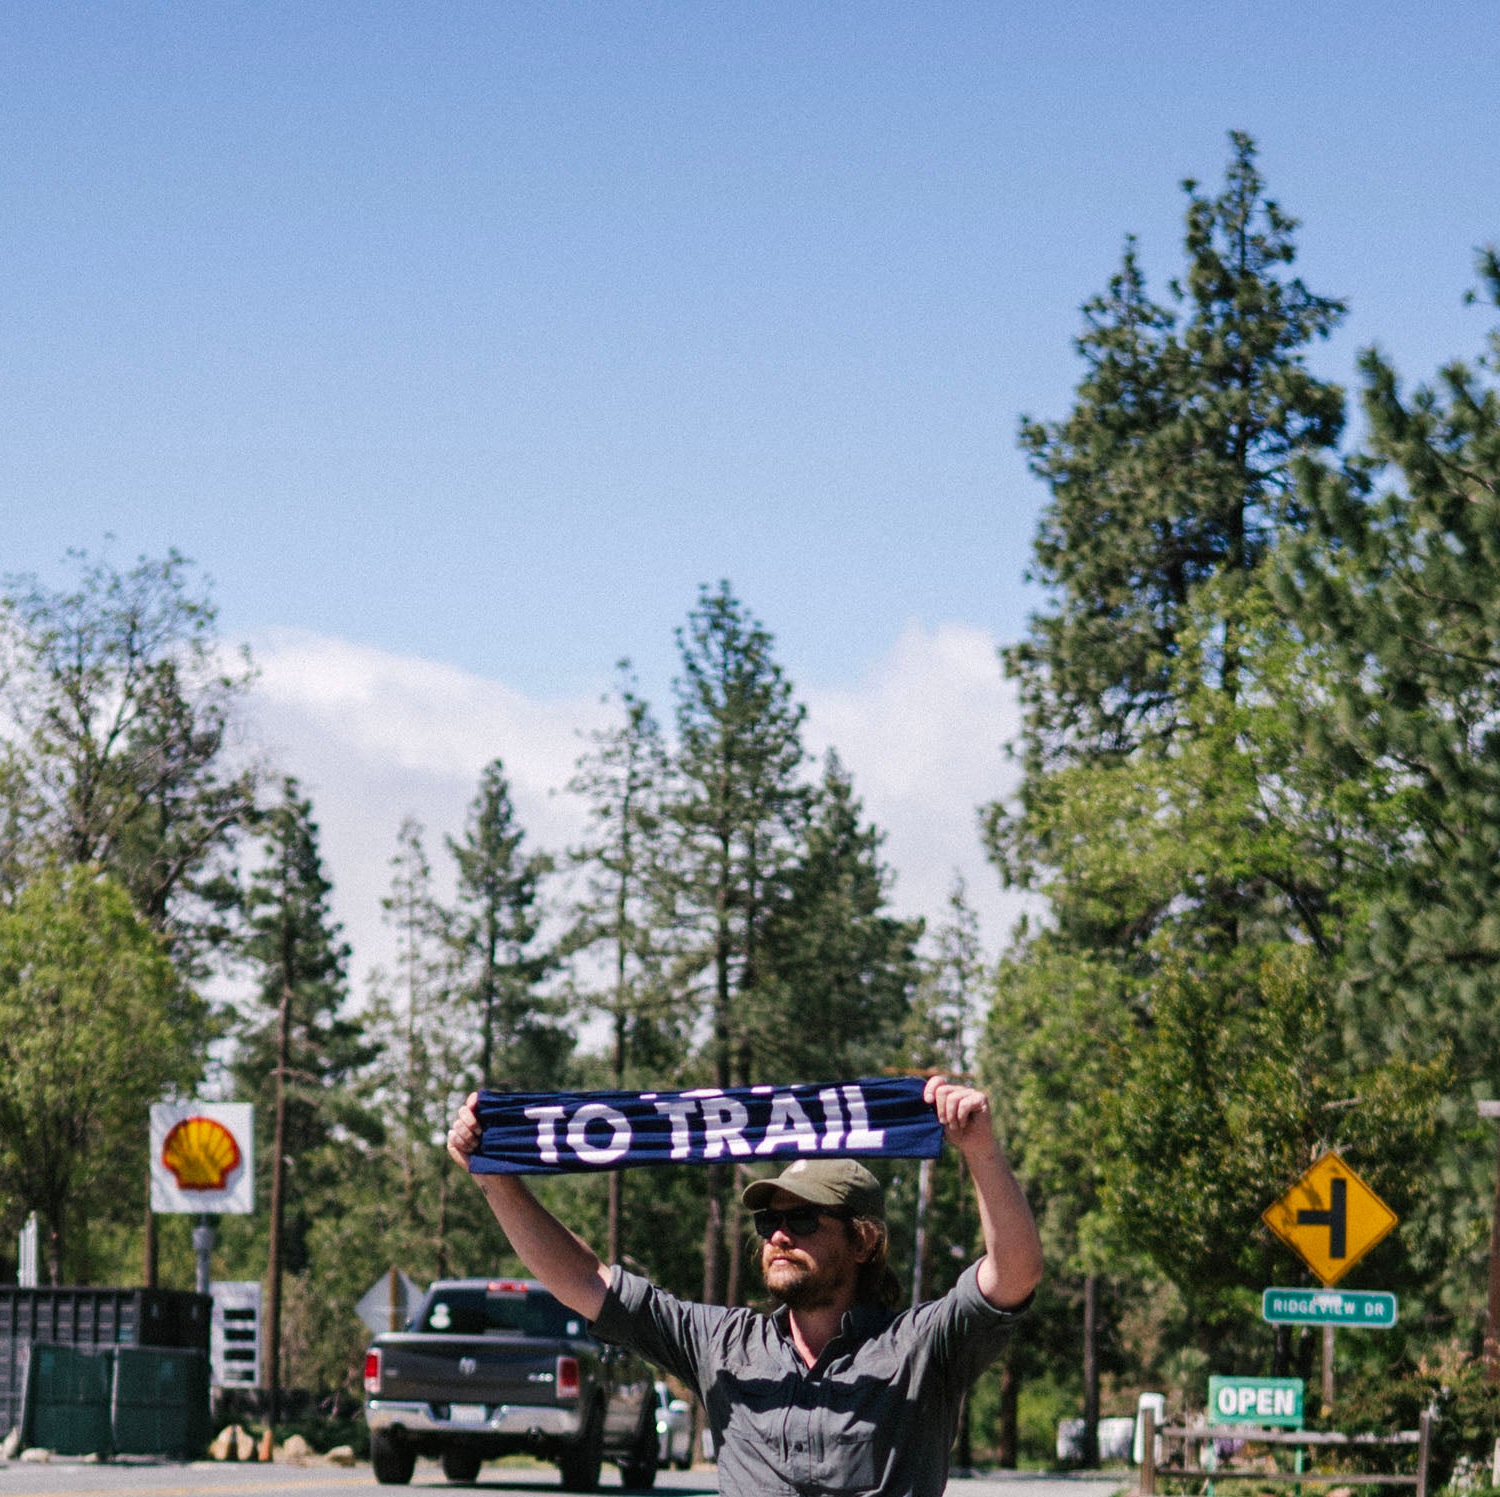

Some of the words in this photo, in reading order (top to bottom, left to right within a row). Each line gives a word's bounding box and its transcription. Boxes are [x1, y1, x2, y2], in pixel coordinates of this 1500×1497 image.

[524, 1103, 632, 1164] TO
[654, 1085, 886, 1159] TRAIL
[1273, 1299, 1356, 1315] RIDGEVIEW
[1364, 1302, 1385, 1316] DR
[1217, 1386, 1295, 1416] OPEN
